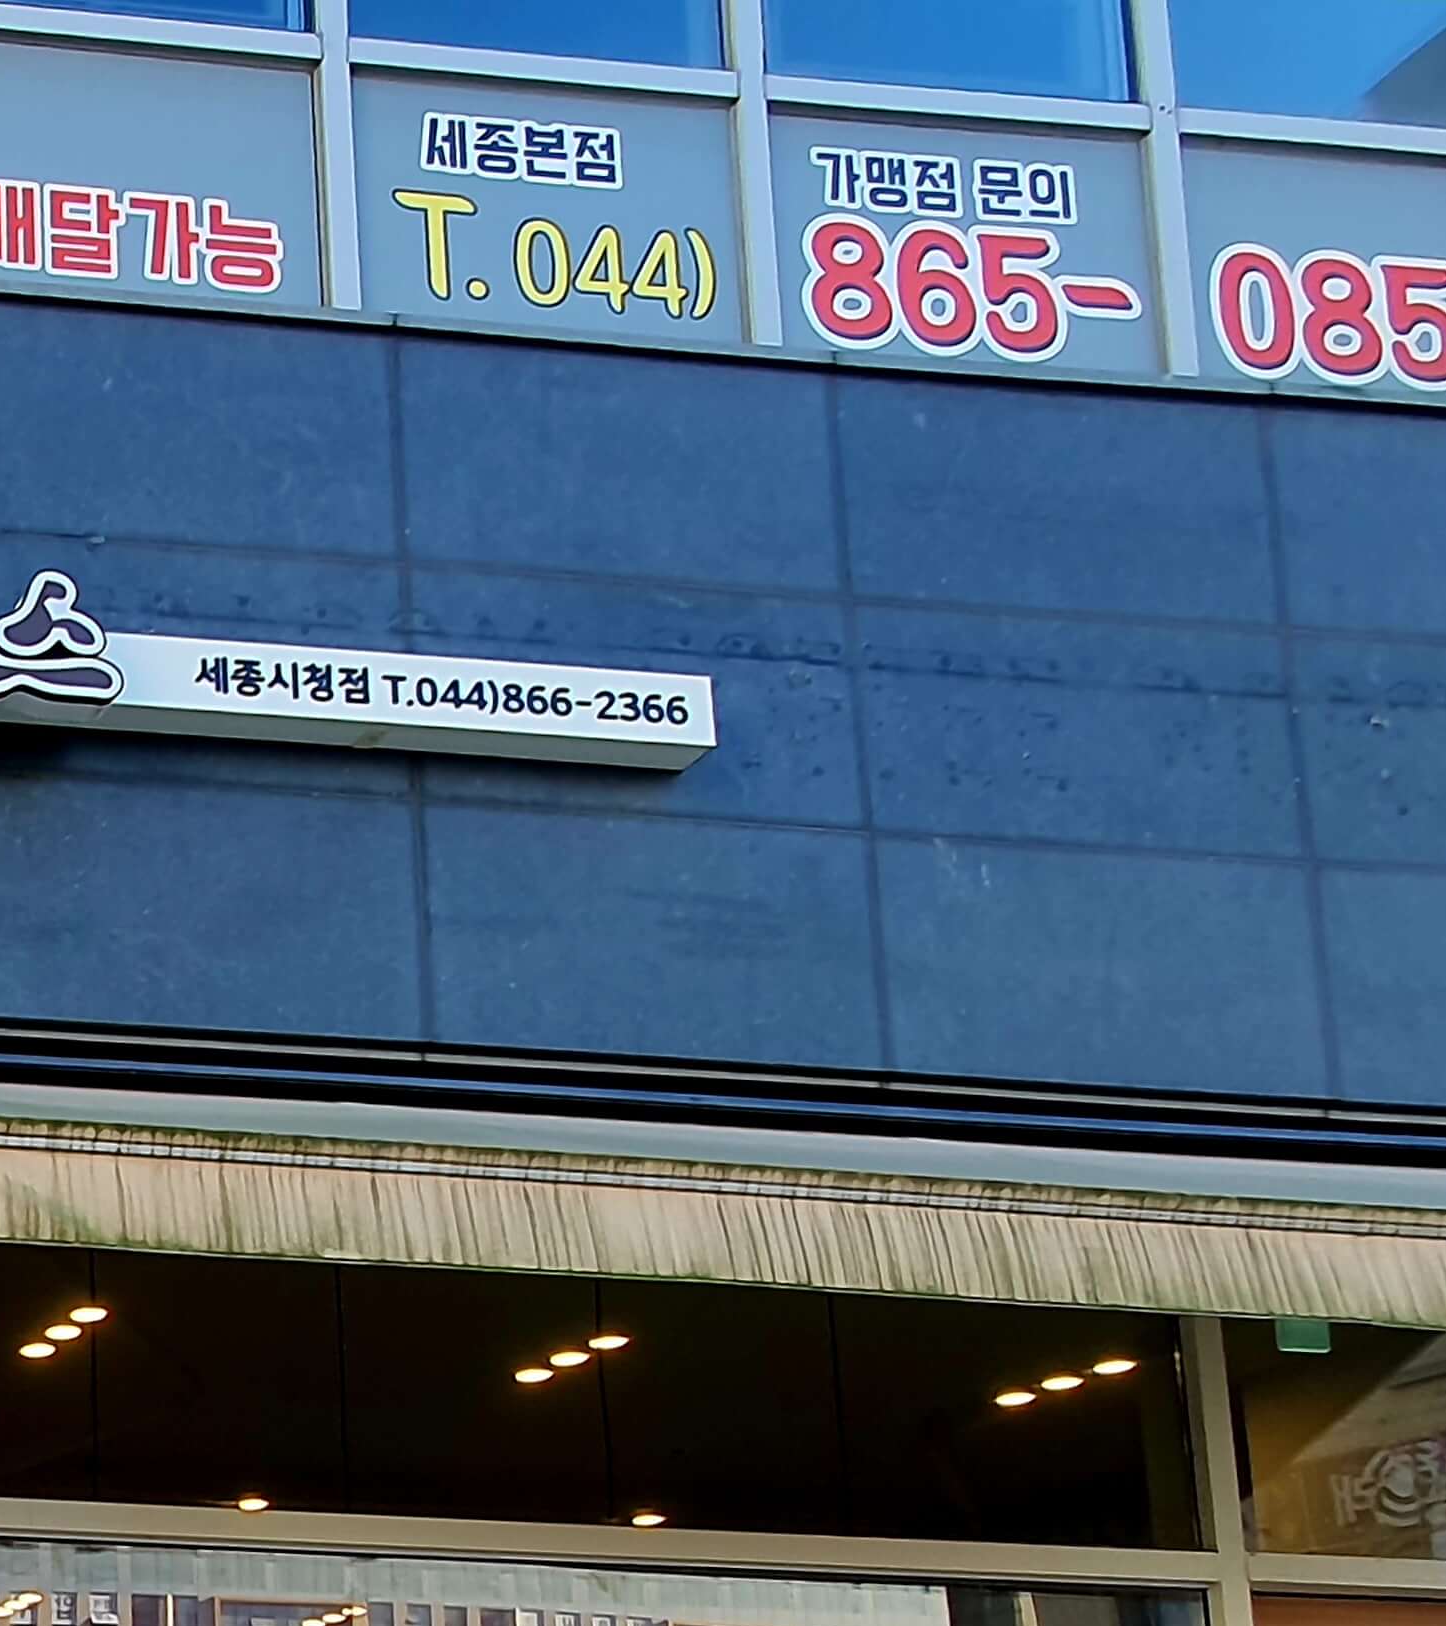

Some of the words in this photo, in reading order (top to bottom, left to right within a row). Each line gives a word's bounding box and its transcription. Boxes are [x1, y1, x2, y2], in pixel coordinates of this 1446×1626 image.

[423, 115, 622, 187] 세종본점
[811, 148, 958, 220] 가맹점
[976, 161, 1075, 224] 문의
[395, 190, 491, 302] T.
[513, 220, 717, 320] 044)
[807, 222, 1139, 358] 865-
[194, 656, 371, 705] 세종시청점
[382, 674, 689, 726] T.044)866-2366
